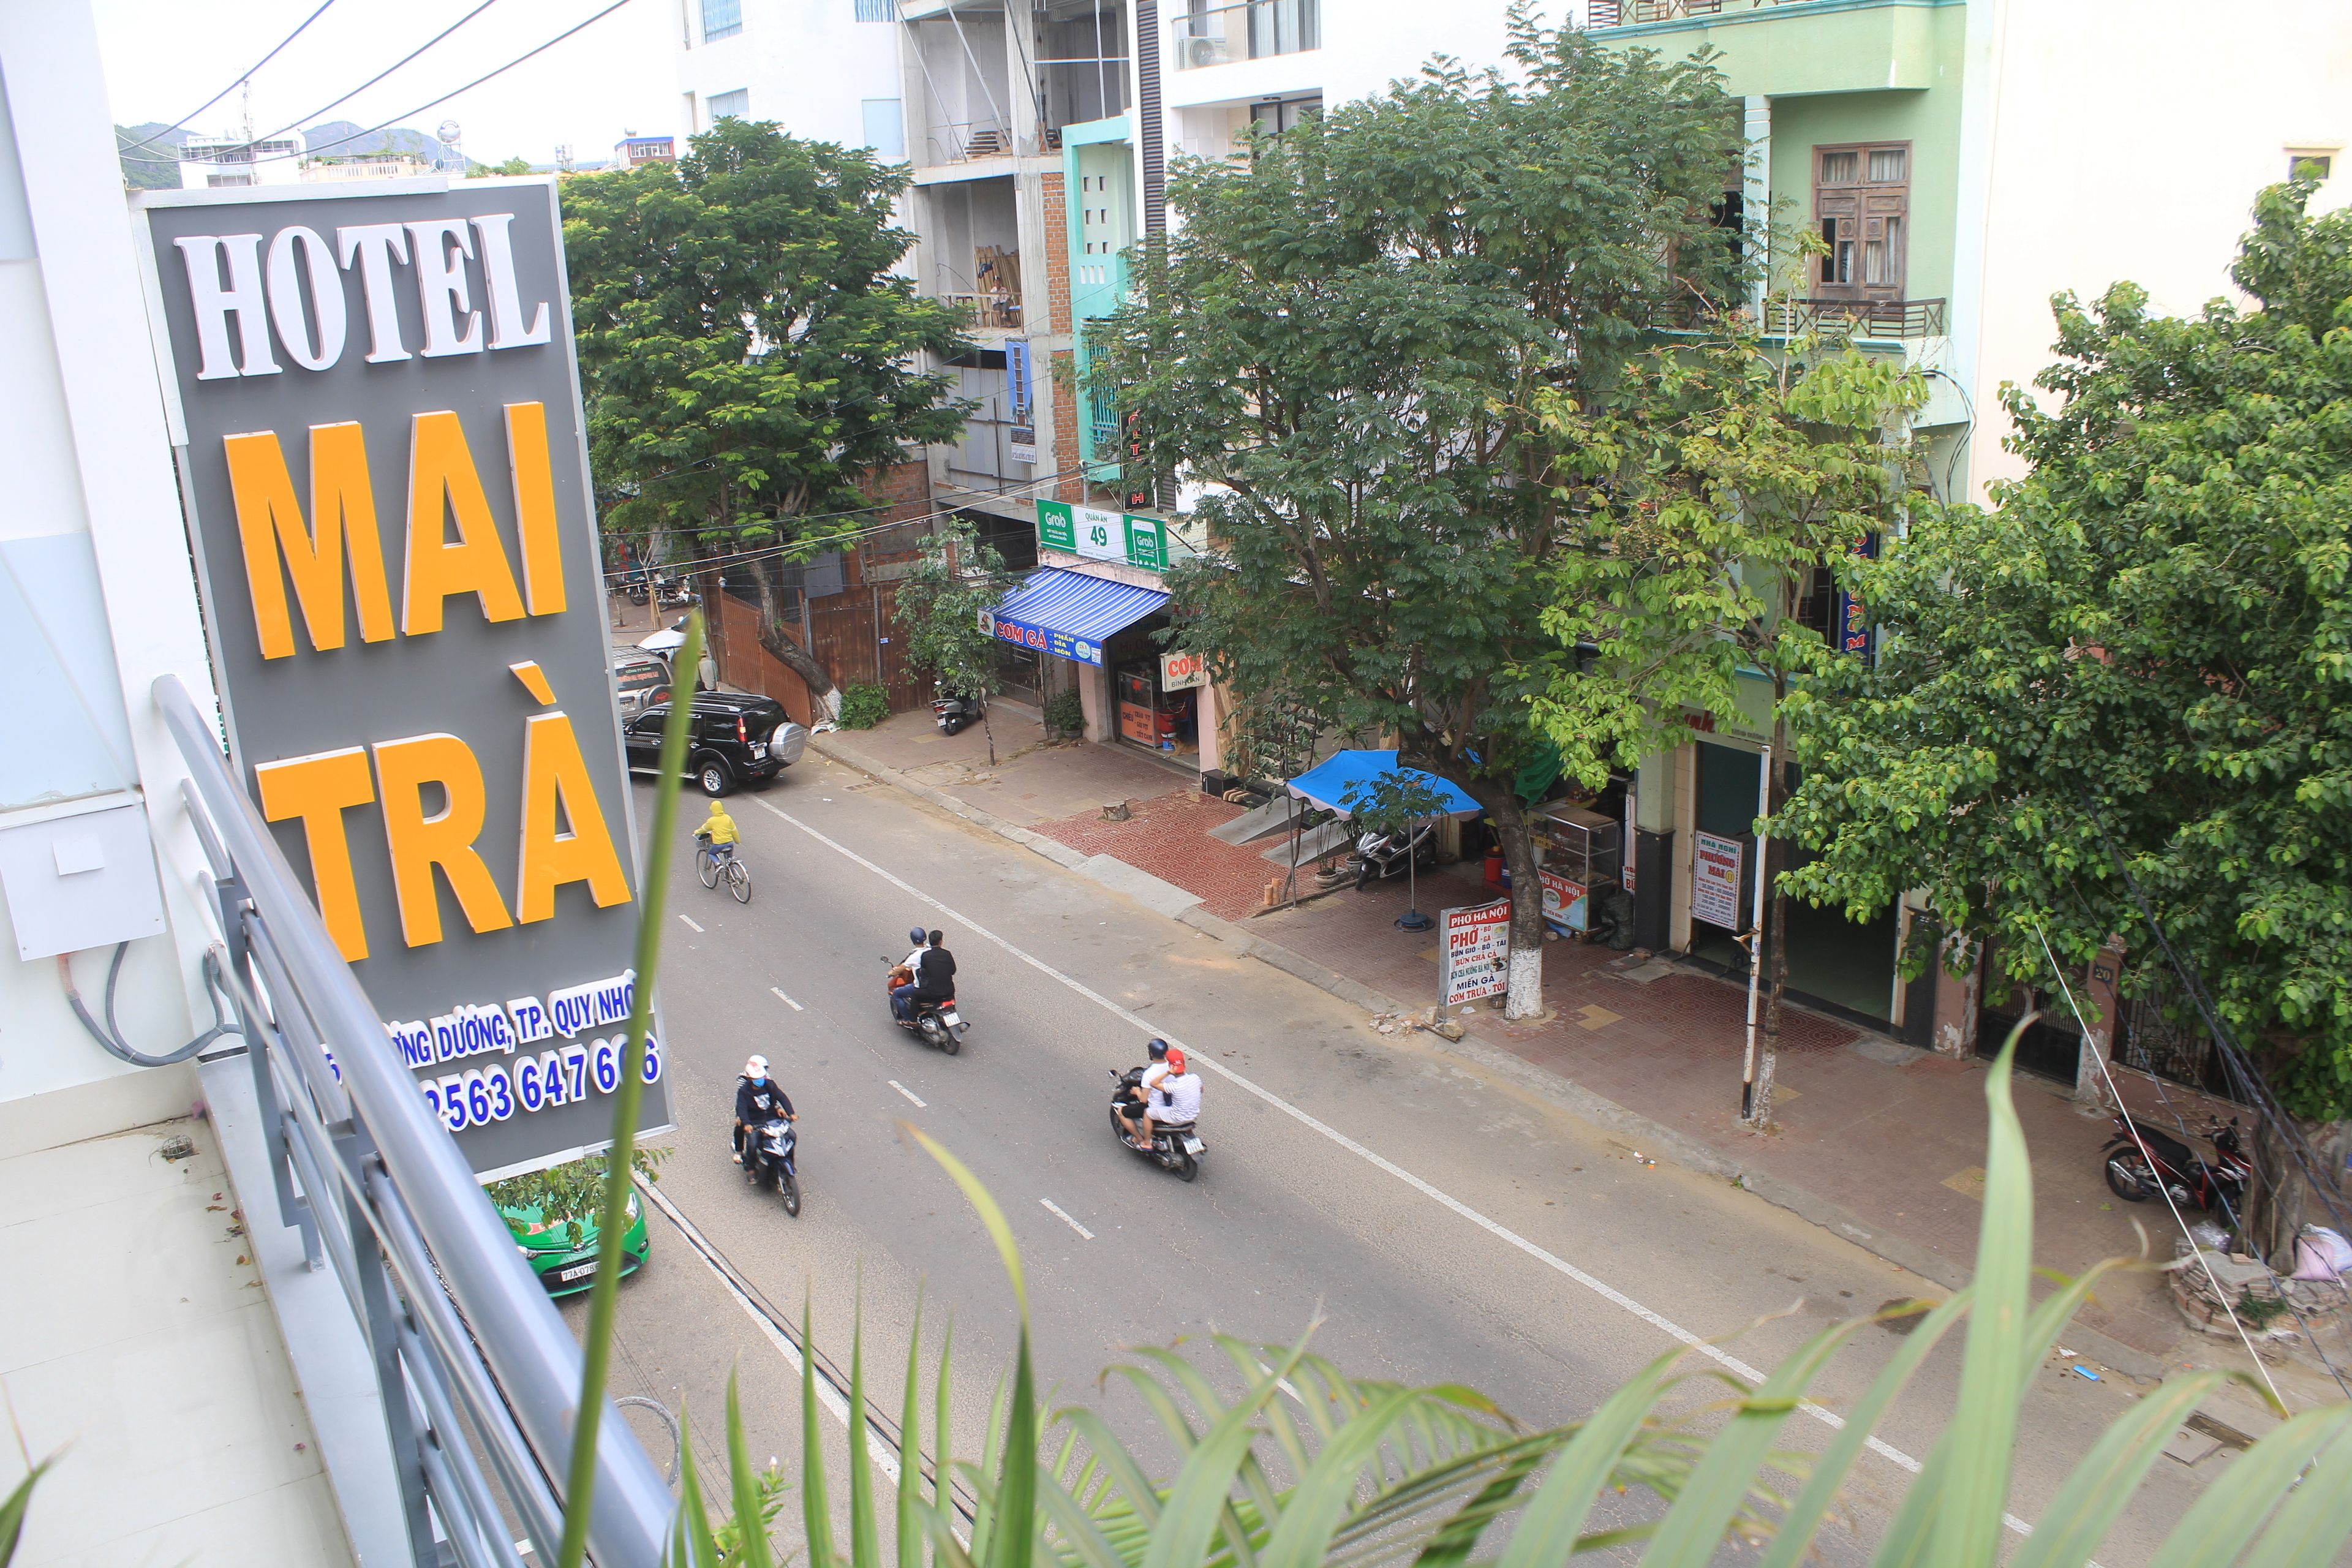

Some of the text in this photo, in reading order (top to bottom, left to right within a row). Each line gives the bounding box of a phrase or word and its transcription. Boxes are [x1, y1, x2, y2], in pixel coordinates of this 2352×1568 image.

[174, 213, 551, 380] HOTEL
[1045, 512, 1066, 528] Grab
[1085, 512, 1099, 521] QUÁN
[223, 401, 567, 660] MAI
[1090, 526, 1107, 546] 49
[1137, 535, 1154, 548] Grab
[995, 621, 1047, 650] CƠM GÀ
[1054, 647, 1071, 657] MÓN
[1168, 654, 1202, 677] CƠM
[254, 660, 632, 963] TRÀ
[1552, 879, 1563, 891] HÀ
[1565, 885, 1580, 897] NỘI
[1489, 906, 1507, 919] NỘI
[1450, 925, 1479, 949] PHỞ
[1455, 956, 1470, 966] BÚN
[1471, 950, 1486, 962] CHẢ
[1449, 979, 1506, 1004] CƠM TRƯA TỐI
[1457, 973, 1495, 990] MIẾN GÀ
[438, 1014, 512, 1058] DƯƠNG,
[515, 1006, 549, 1039] TP.
[555, 993, 590, 1035] QUY
[522, 1054, 585, 1109] 647
[597, 1038, 658, 1090] 66
